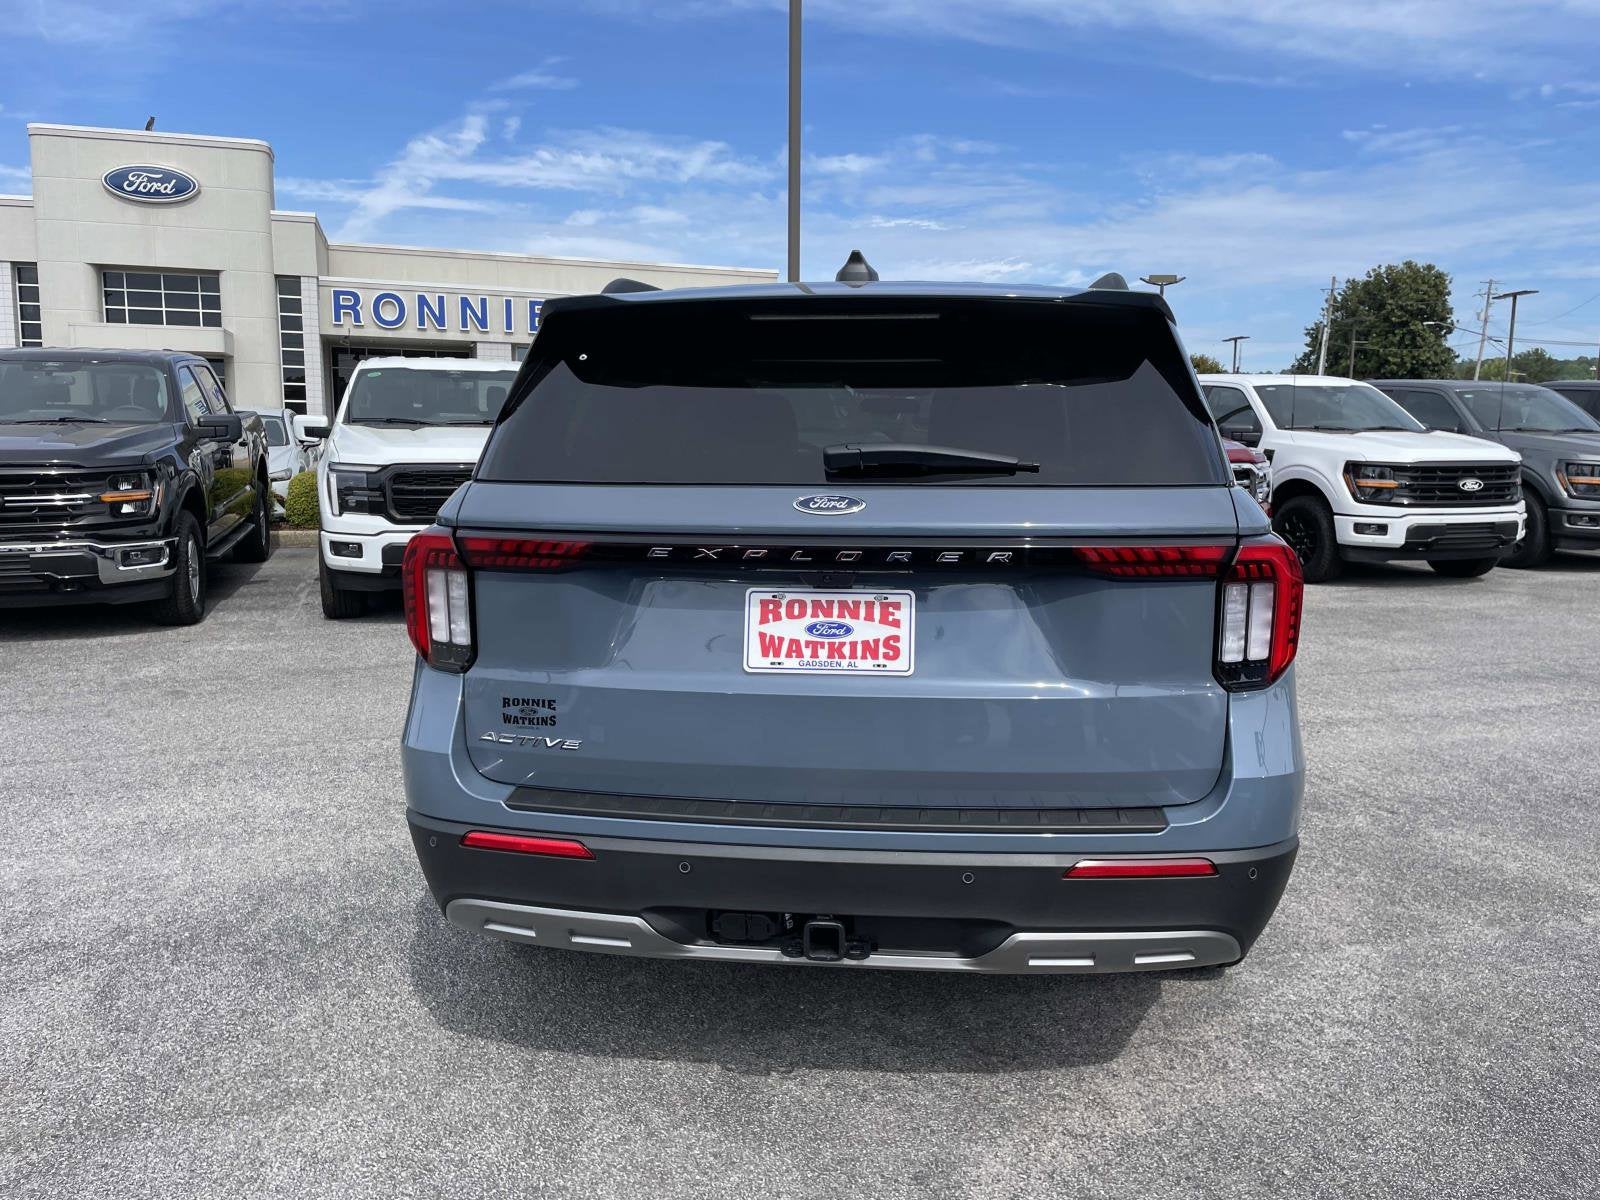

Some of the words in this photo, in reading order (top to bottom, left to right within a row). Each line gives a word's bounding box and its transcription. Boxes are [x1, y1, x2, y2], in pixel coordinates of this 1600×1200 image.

[123, 171, 176, 194] Ford
[809, 496, 849, 509] Ford
[647, 547, 1013, 563] EXPLORER
[758, 598, 902, 629] RONNIE
[812, 622, 847, 636] Ford
[758, 631, 902, 662] WATKINS
[798, 660, 844, 669] GADSDEN,
[846, 661, 859, 669] AL
[502, 697, 557, 711] RONNIE
[502, 713, 557, 727] WATKINS
[480, 731, 583, 750] ACTIVE
